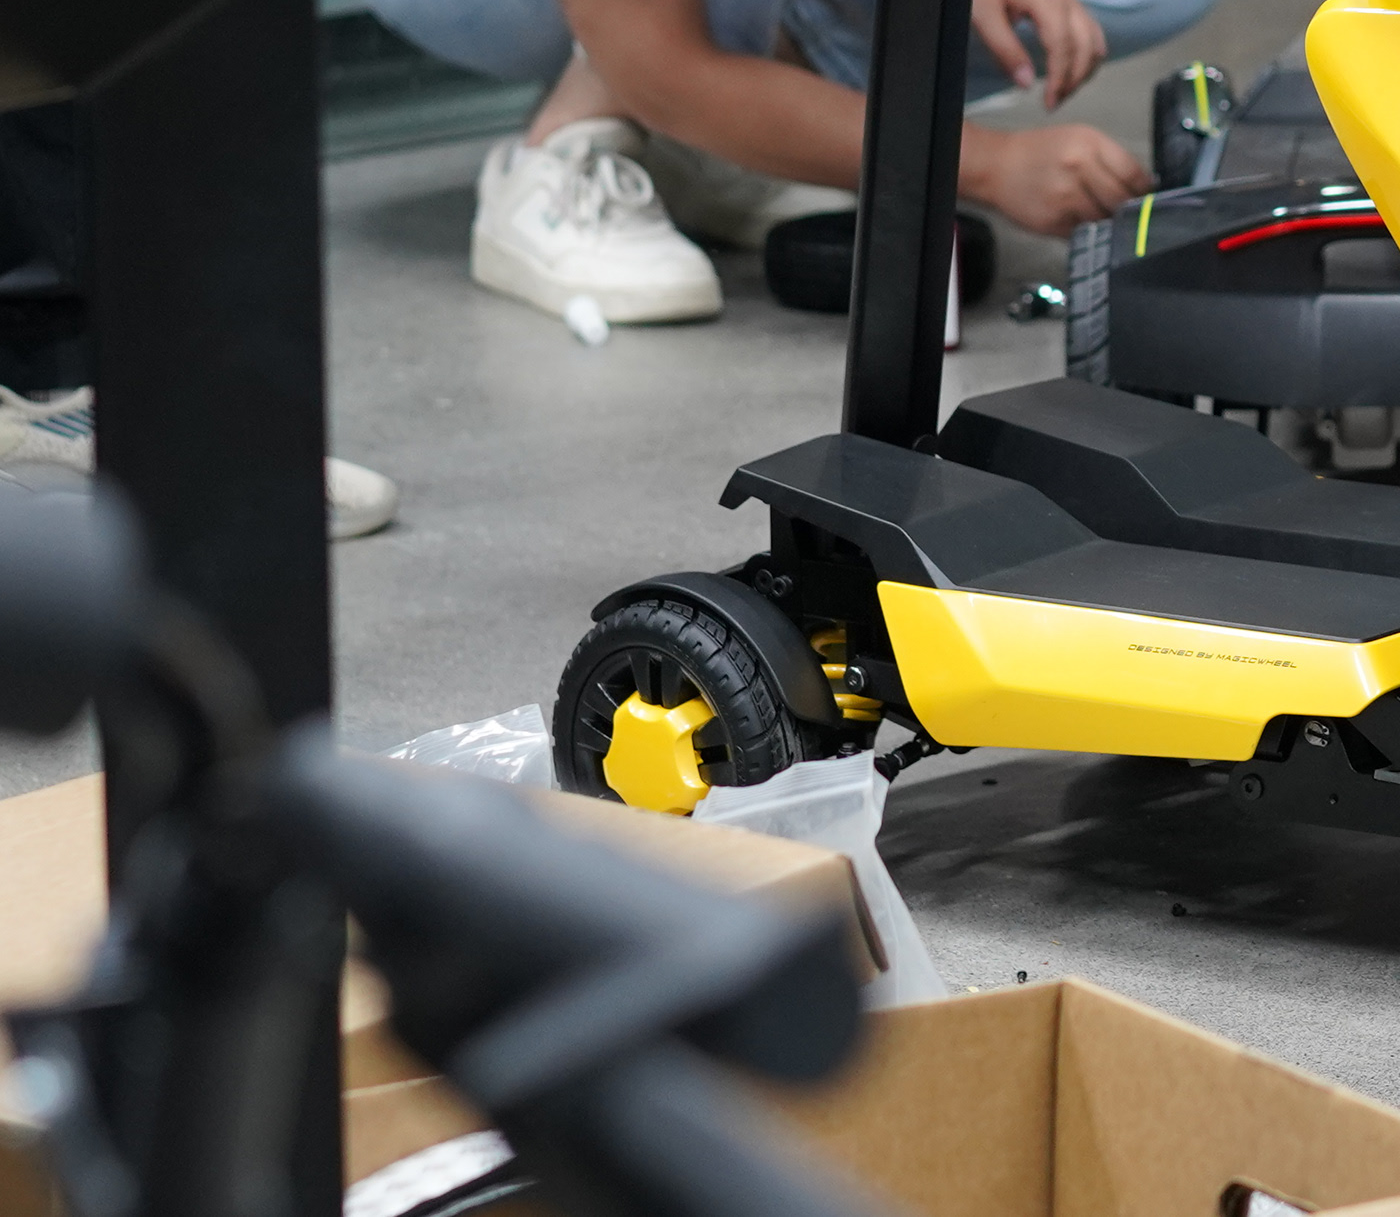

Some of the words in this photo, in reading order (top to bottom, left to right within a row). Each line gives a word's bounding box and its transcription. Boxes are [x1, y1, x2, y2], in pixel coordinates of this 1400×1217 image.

[1128, 643, 1194, 657] DESIGNED
[1196, 651, 1214, 659] BY
[1216, 653, 1297, 669] MAGICWHEEL
